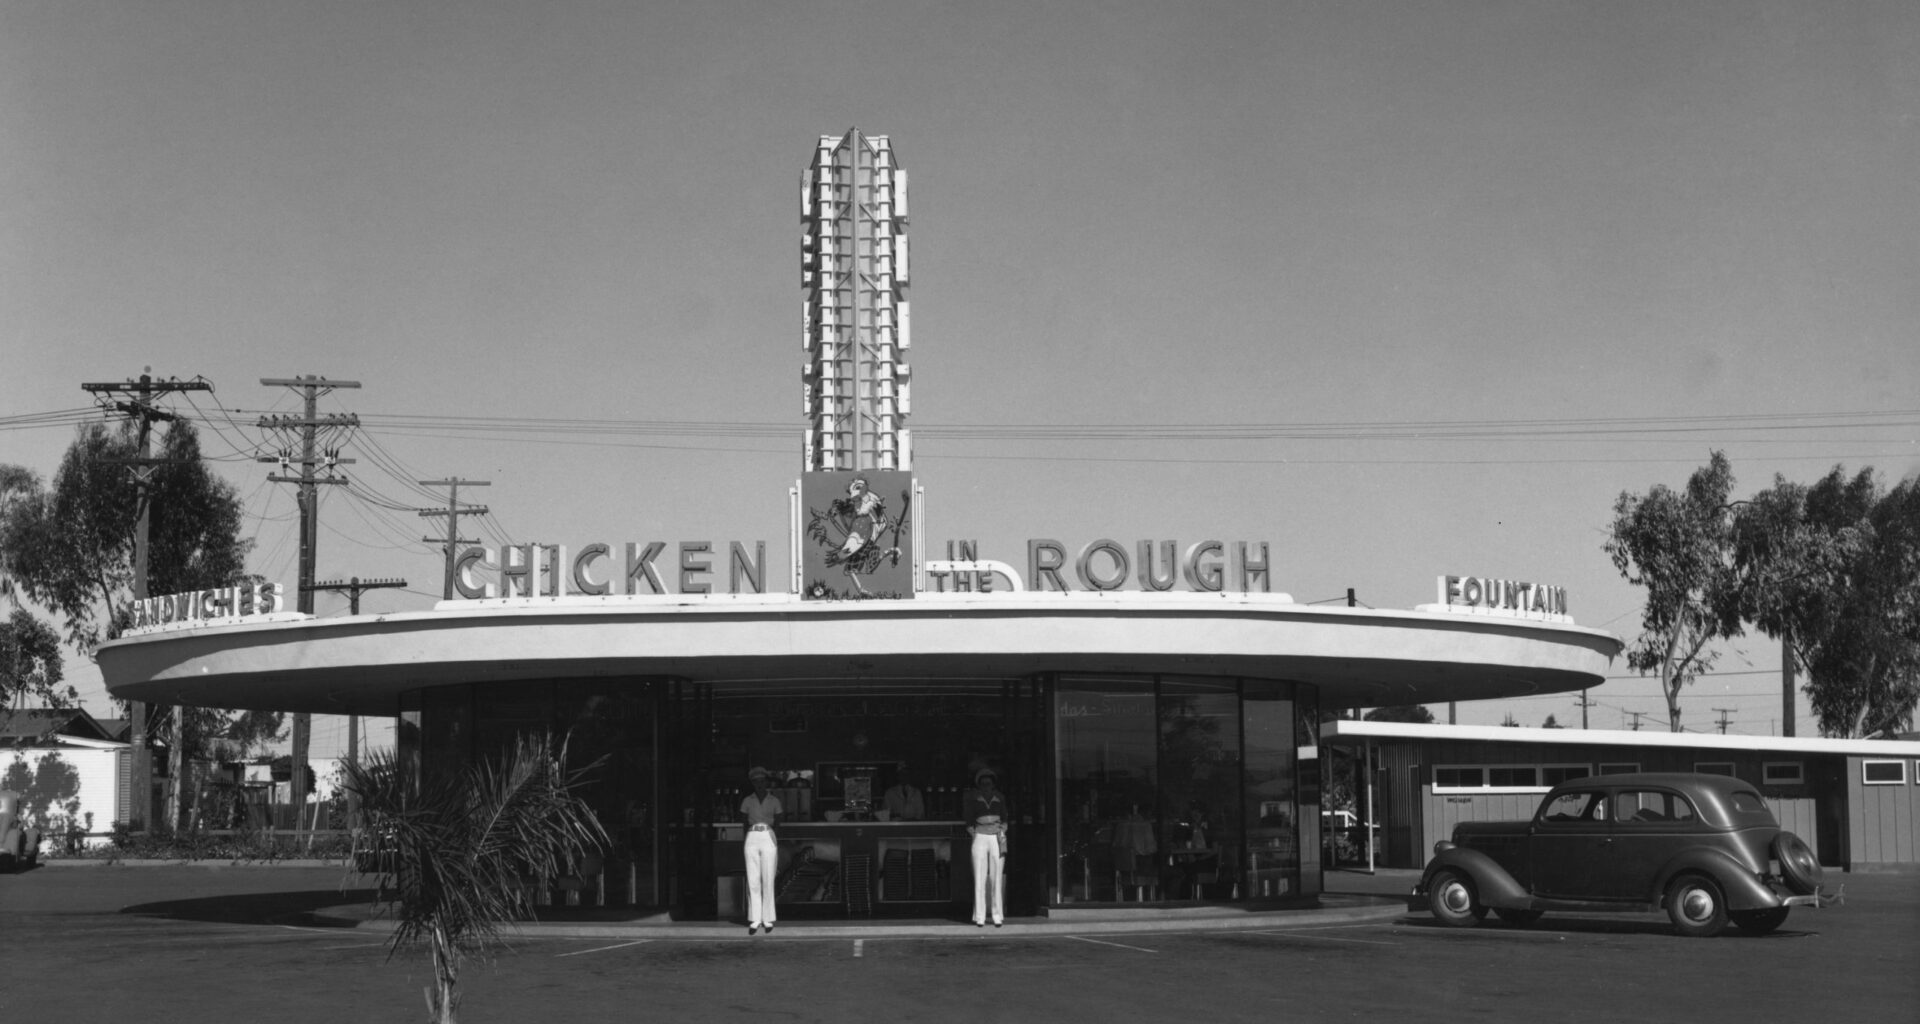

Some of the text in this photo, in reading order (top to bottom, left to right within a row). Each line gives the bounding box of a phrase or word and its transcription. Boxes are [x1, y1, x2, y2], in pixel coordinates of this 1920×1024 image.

[454, 541, 767, 599] CHICKEN
[946, 540, 977, 562] IN
[1027, 538, 1271, 594] ROUGH
[930, 568, 994, 593] THE
[1441, 575, 1568, 616] FOUNTAIN
[126, 582, 281, 628] SANDWICHES
